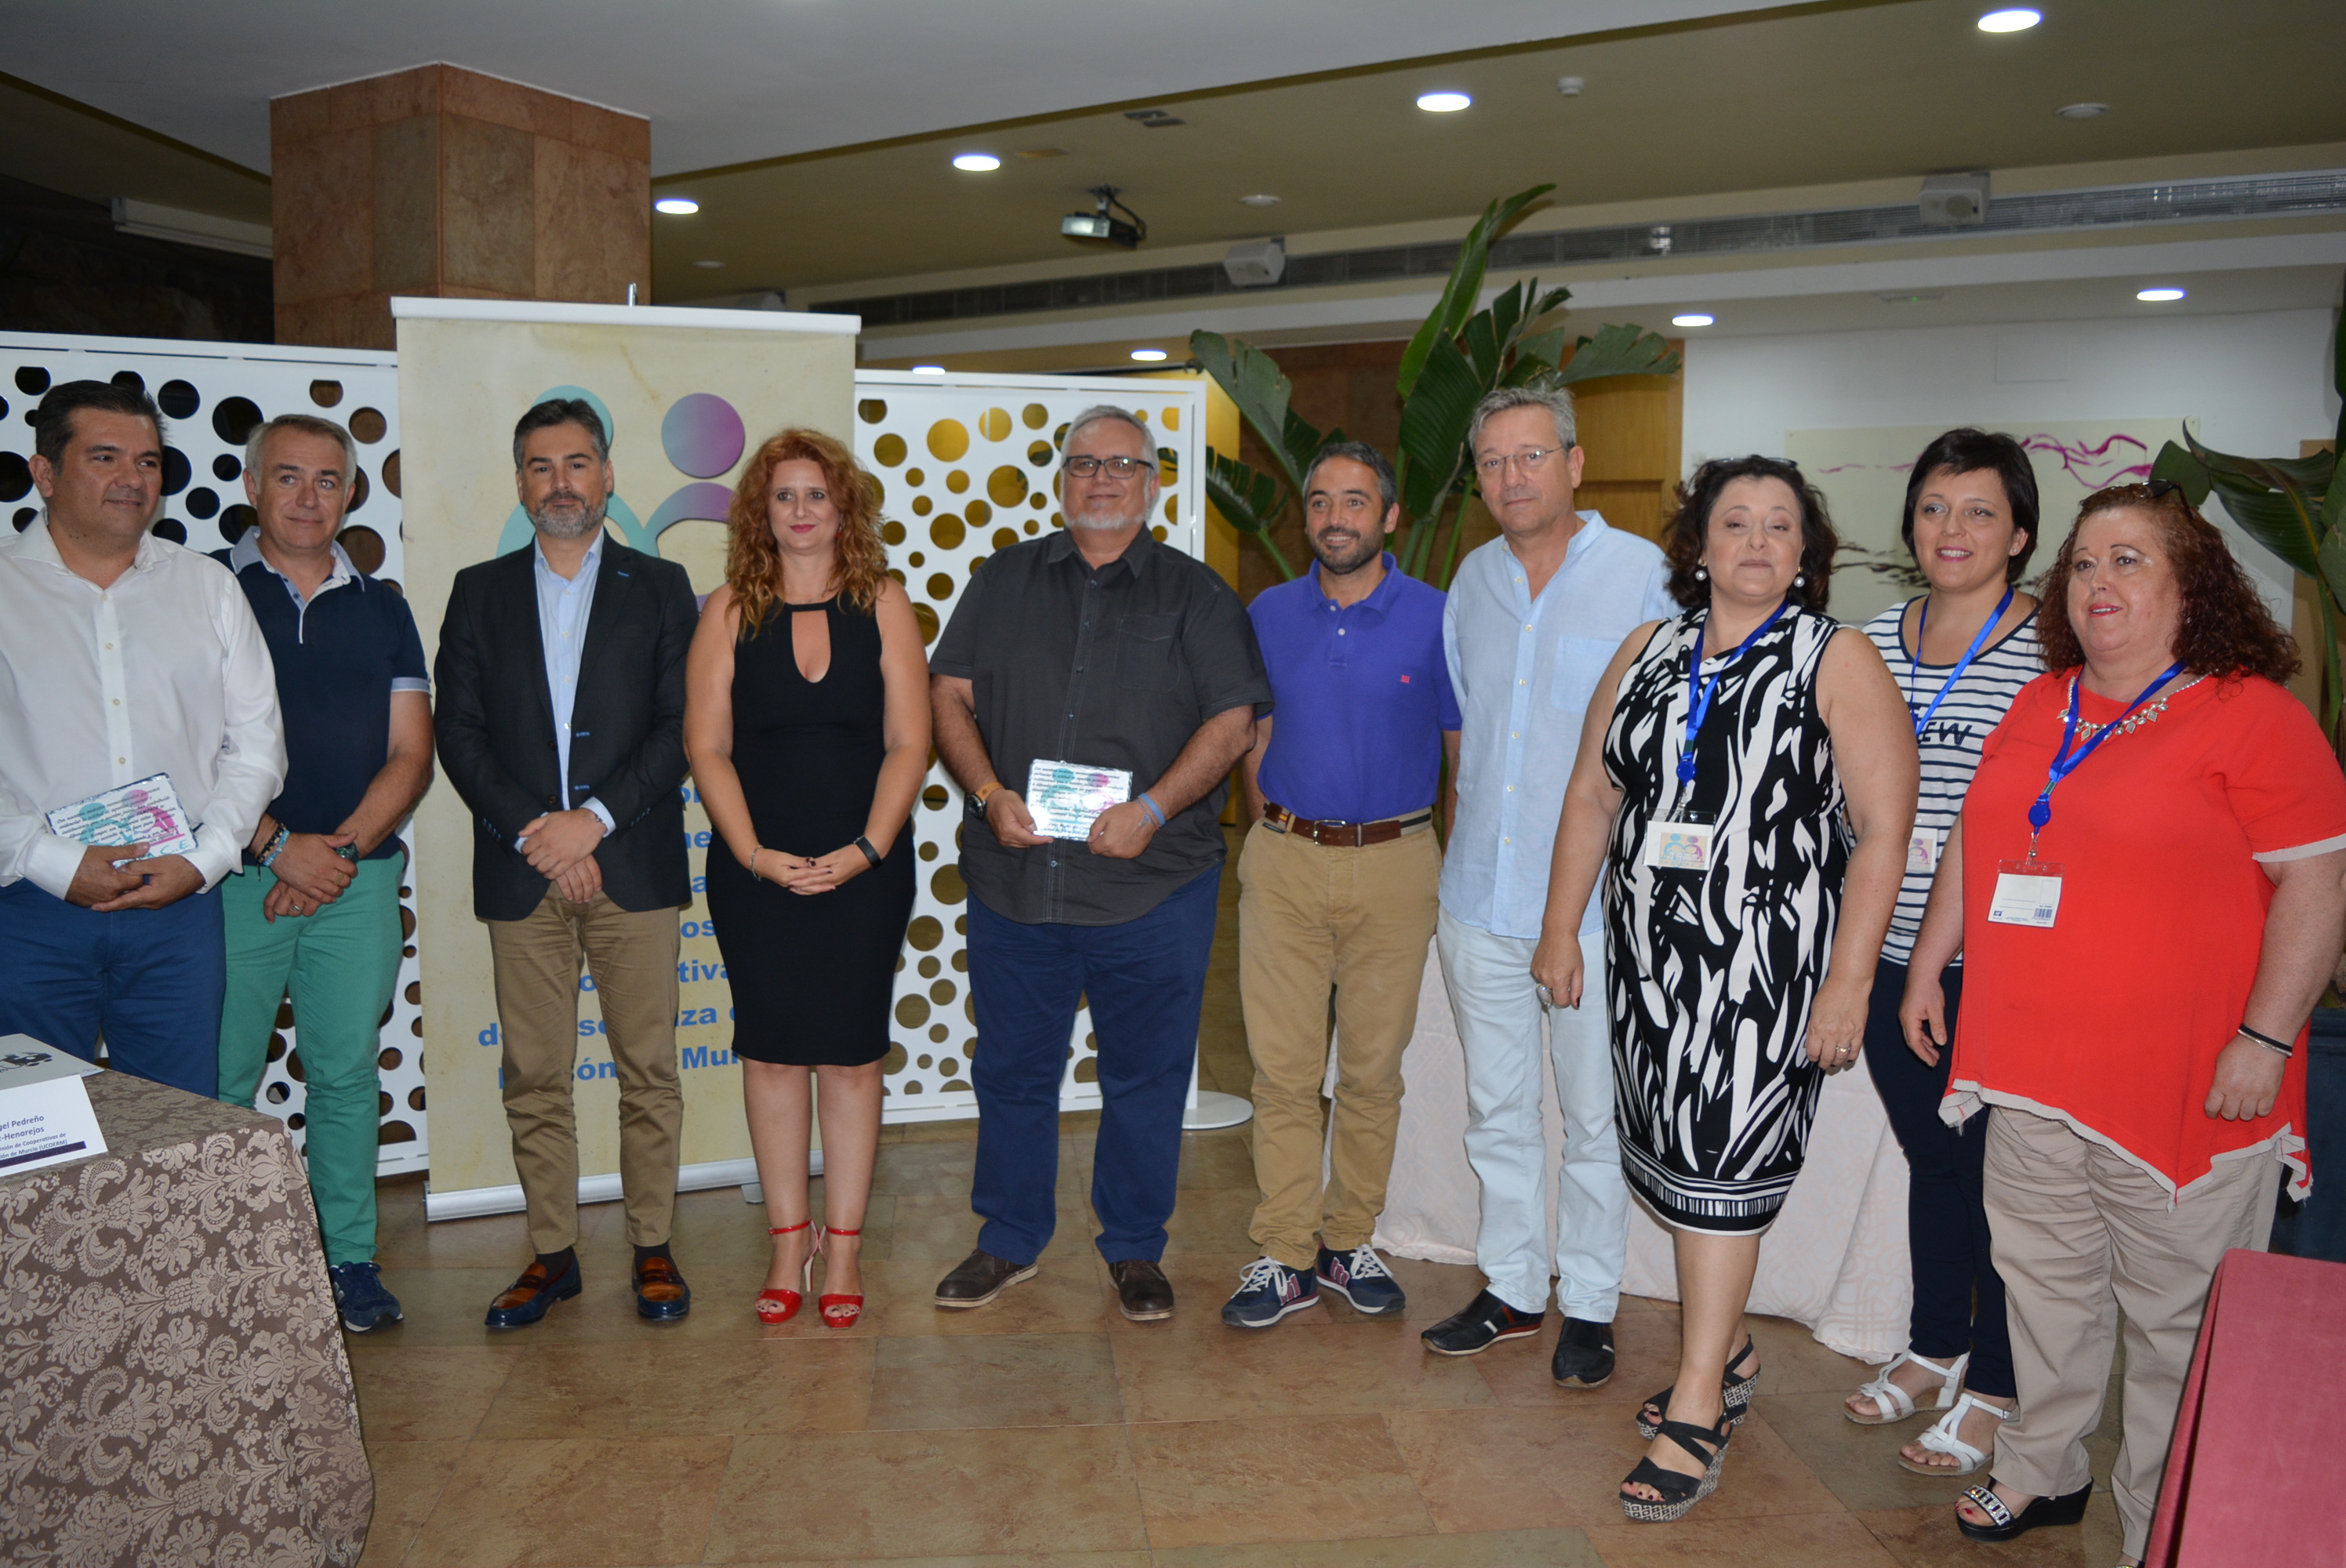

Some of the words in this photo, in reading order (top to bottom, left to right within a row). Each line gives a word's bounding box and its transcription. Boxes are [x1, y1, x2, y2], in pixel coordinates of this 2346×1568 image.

[12, 1116, 45, 1127] Pedreño
[22, 1134, 59, 1146] Cooperativas
[18, 1146, 38, 1155] Murcia
